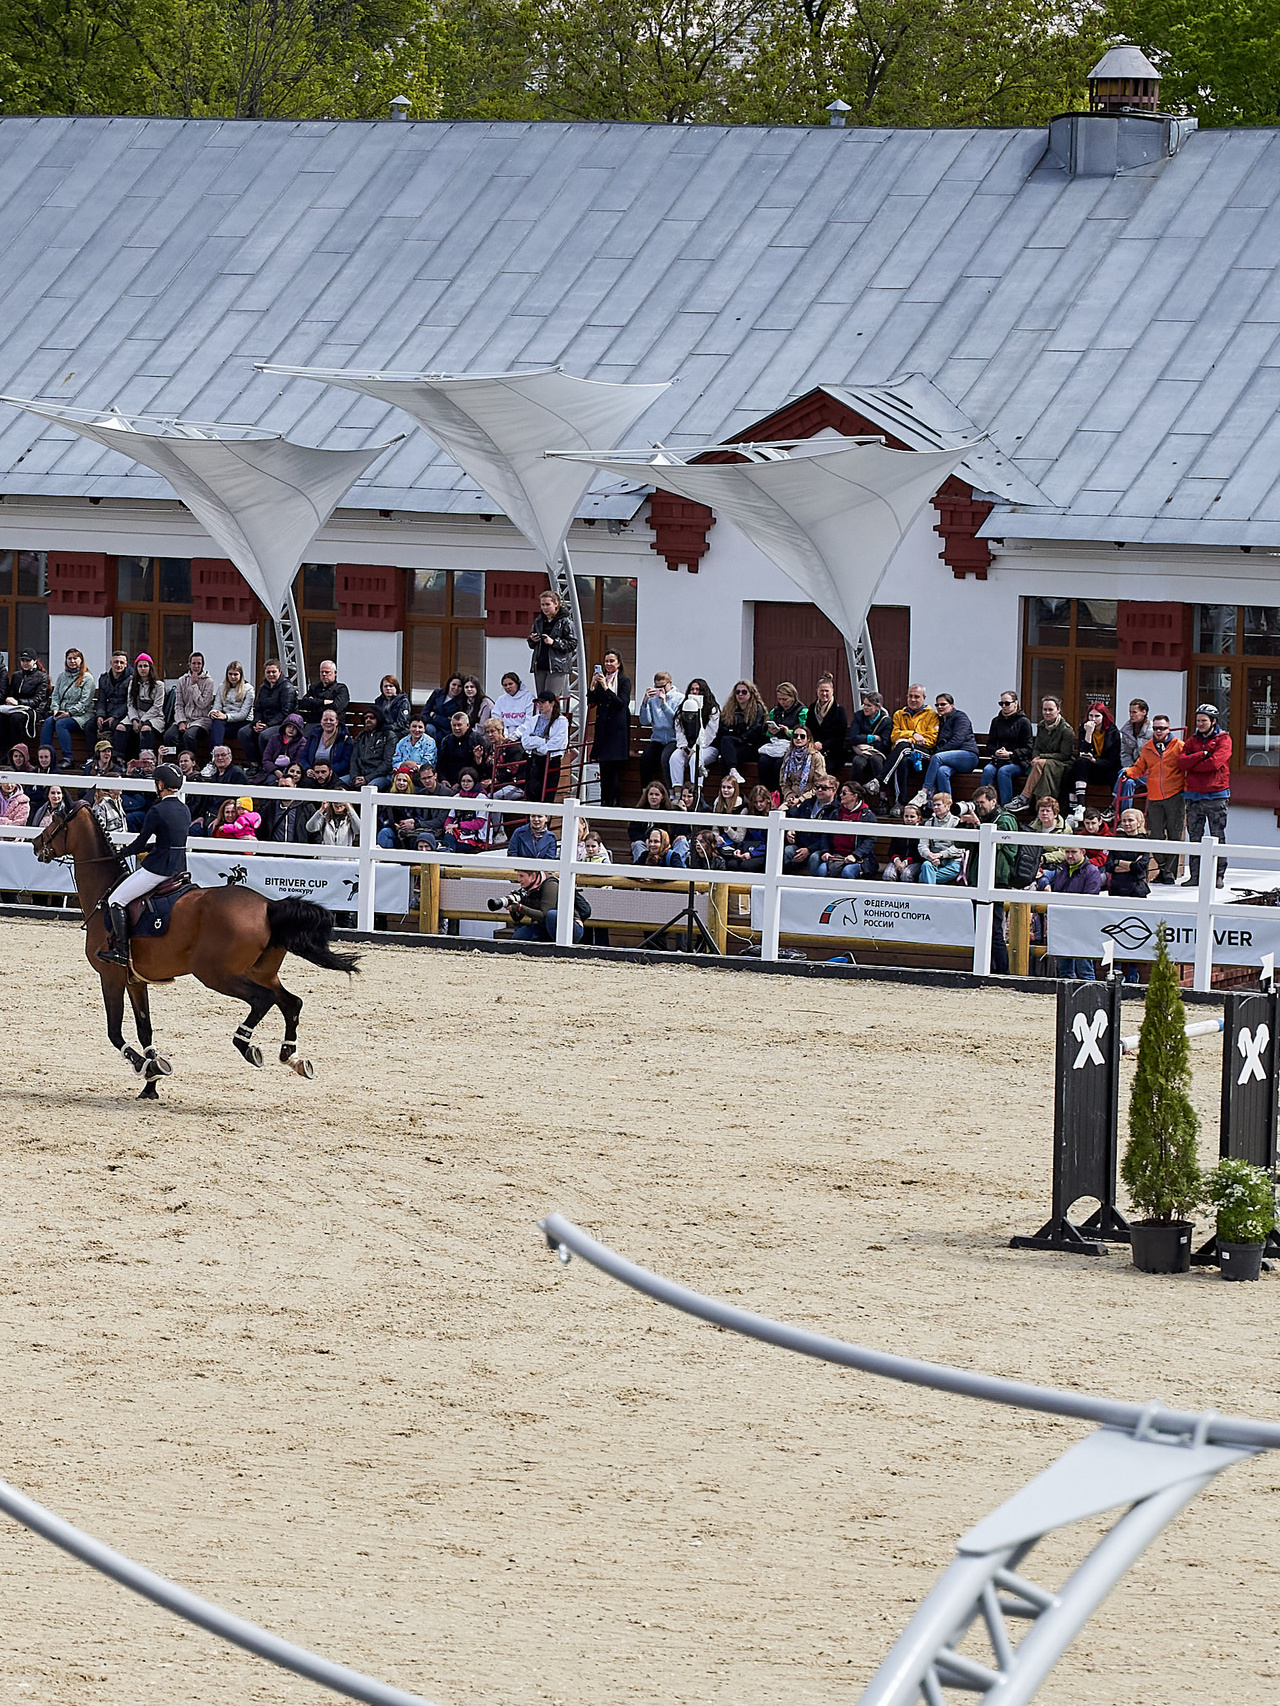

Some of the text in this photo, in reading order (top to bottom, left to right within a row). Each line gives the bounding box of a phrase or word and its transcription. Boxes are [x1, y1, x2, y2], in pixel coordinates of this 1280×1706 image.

[264, 877, 328, 888] BITRIVER CUP
[864, 899, 910, 910] ФЕДЕРАЦИЯ
[864, 909, 931, 921] КОННОГО СПОРТА
[863, 919, 895, 928] РОССИИ
[1163, 927, 1254, 947] BITVER
